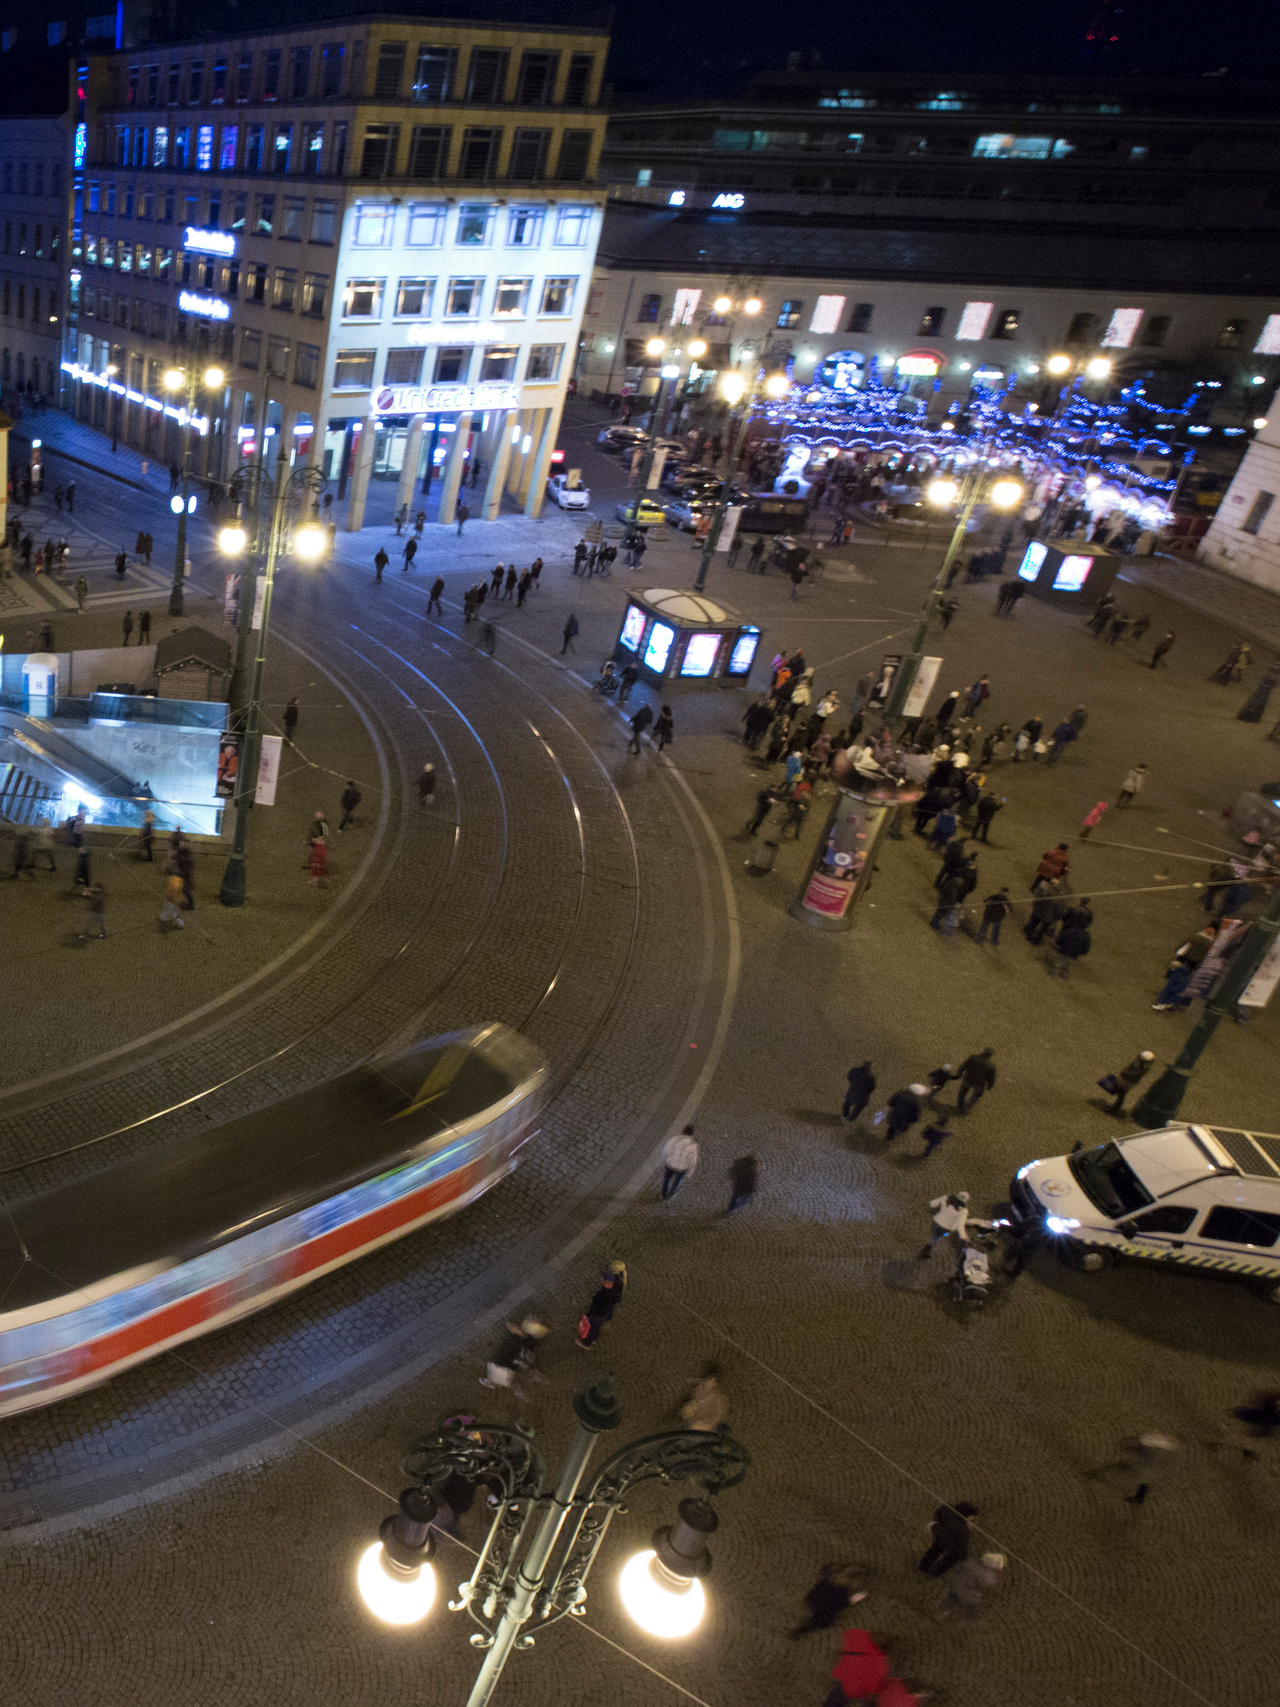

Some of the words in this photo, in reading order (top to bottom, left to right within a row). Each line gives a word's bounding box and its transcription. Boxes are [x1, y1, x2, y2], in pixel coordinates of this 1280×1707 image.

[711, 193, 745, 209] AIG
[394, 385, 474, 410] UniCredit
[477, 384, 521, 408] Bank
